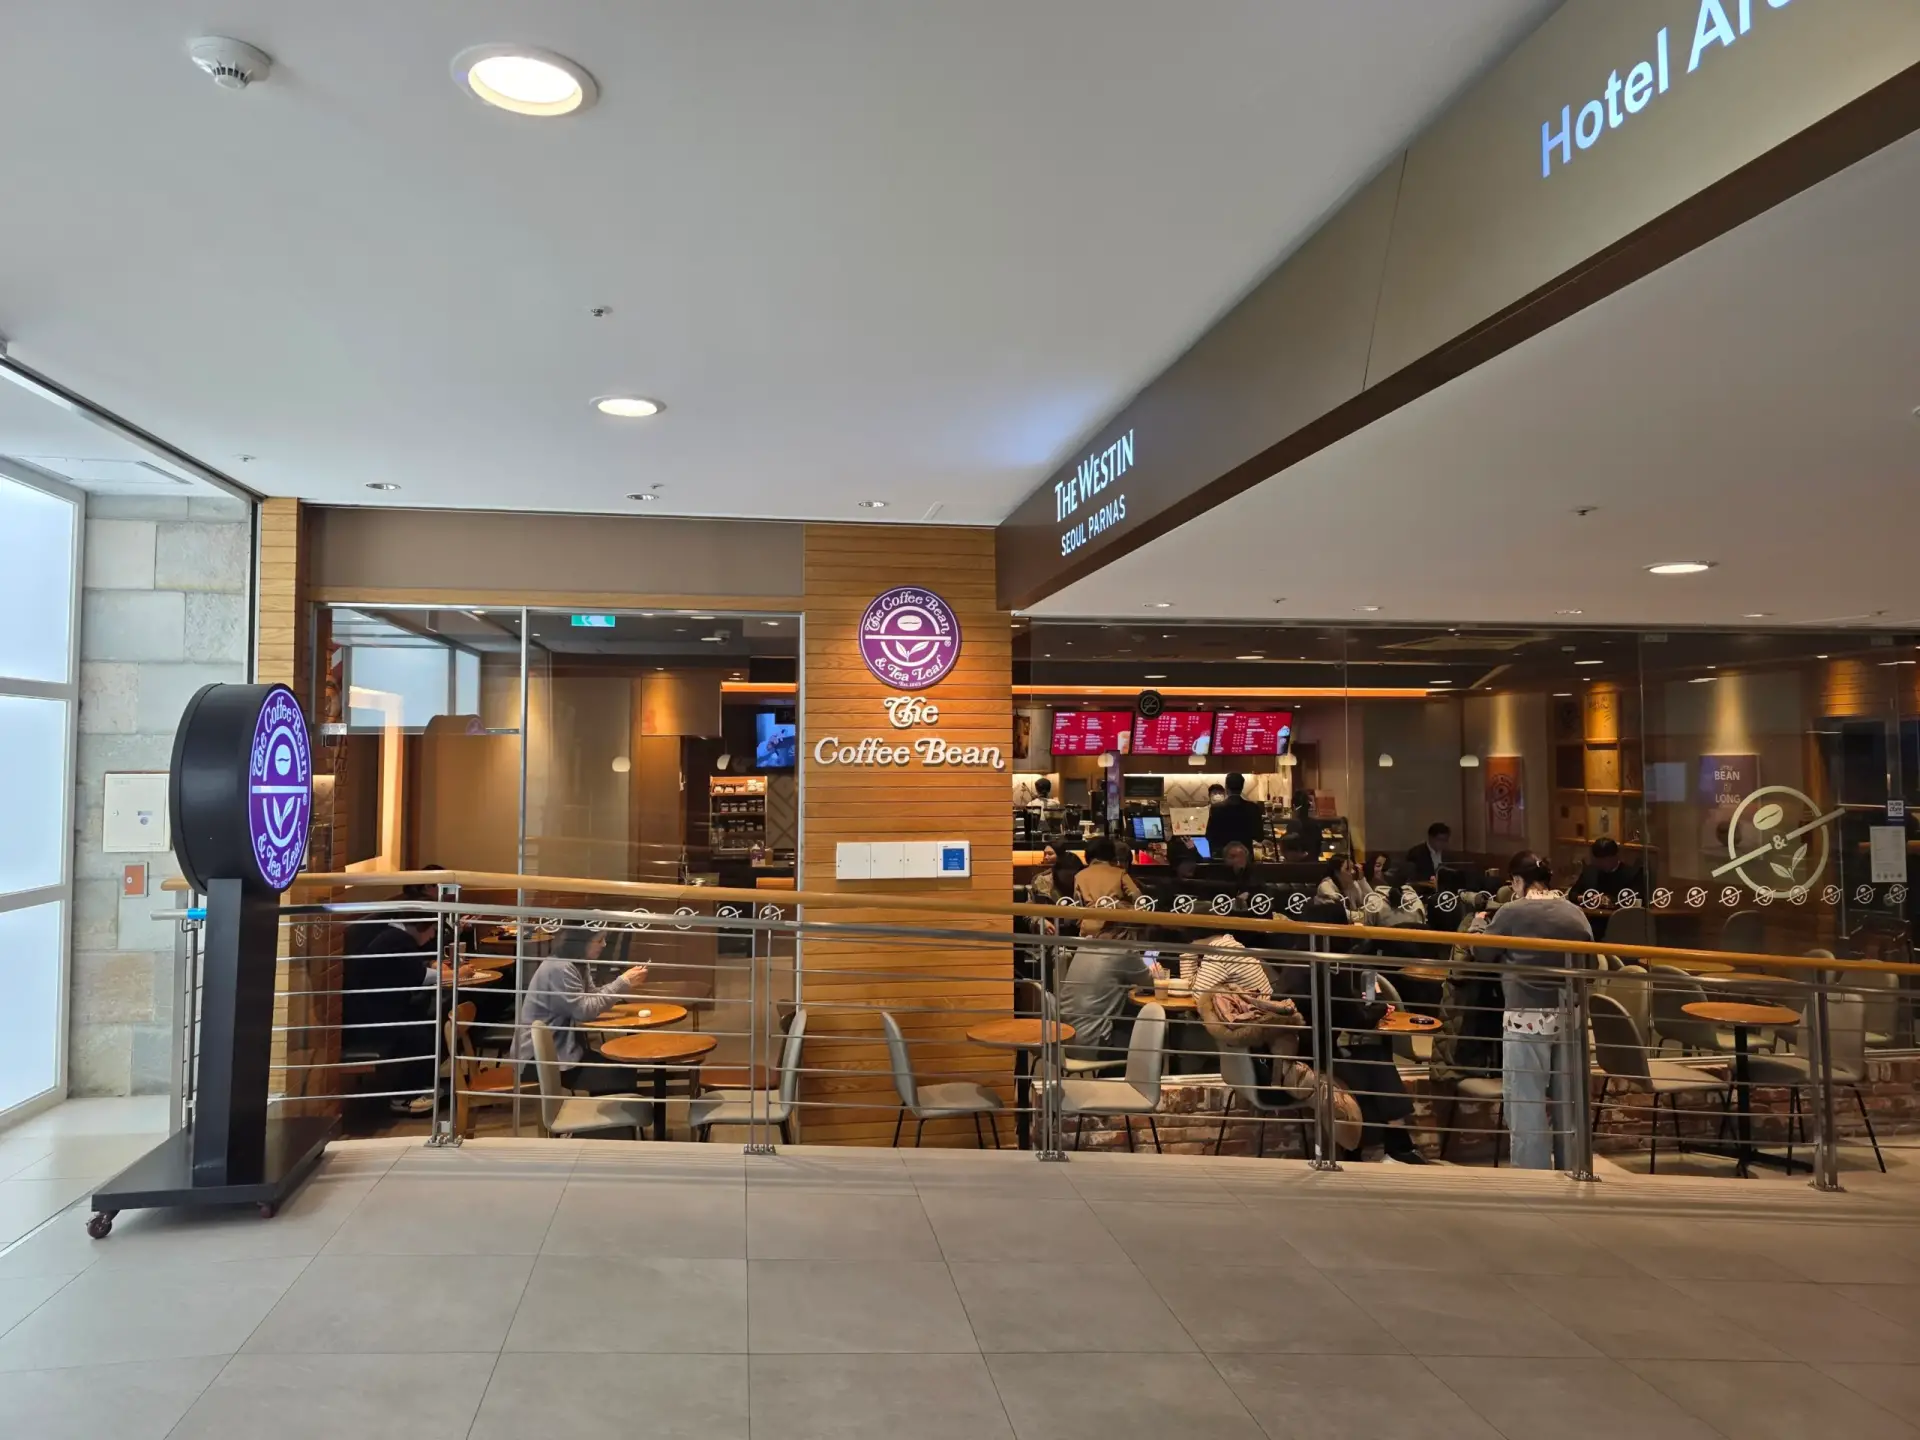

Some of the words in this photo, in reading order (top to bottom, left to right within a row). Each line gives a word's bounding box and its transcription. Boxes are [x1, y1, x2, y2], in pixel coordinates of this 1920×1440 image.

[1540, 27, 1669, 178] Hotel
[1054, 481, 1078, 522] THE
[1077, 428, 1134, 503] WESTIN
[1061, 522, 1087, 556] SEOUL
[1088, 494, 1126, 539] PARNAS
[865, 609, 885, 632] The
[881, 591, 923, 611] Coffee
[925, 596, 950, 634] Bean
[874, 657, 887, 670] &
[887, 664, 909, 681] Tea
[911, 654, 944, 681] Leaf
[883, 696, 939, 728] The
[252, 732, 267, 776] The
[264, 696, 292, 733] Coffee
[292, 708, 308, 781] Bean
[814, 736, 911, 765] Coffee
[914, 737, 1005, 769] Bean
[1714, 770, 1741, 781] BEAN
[257, 832, 267, 859] &
[266, 844, 281, 878] Tea
[281, 821, 302, 874] Leaf
